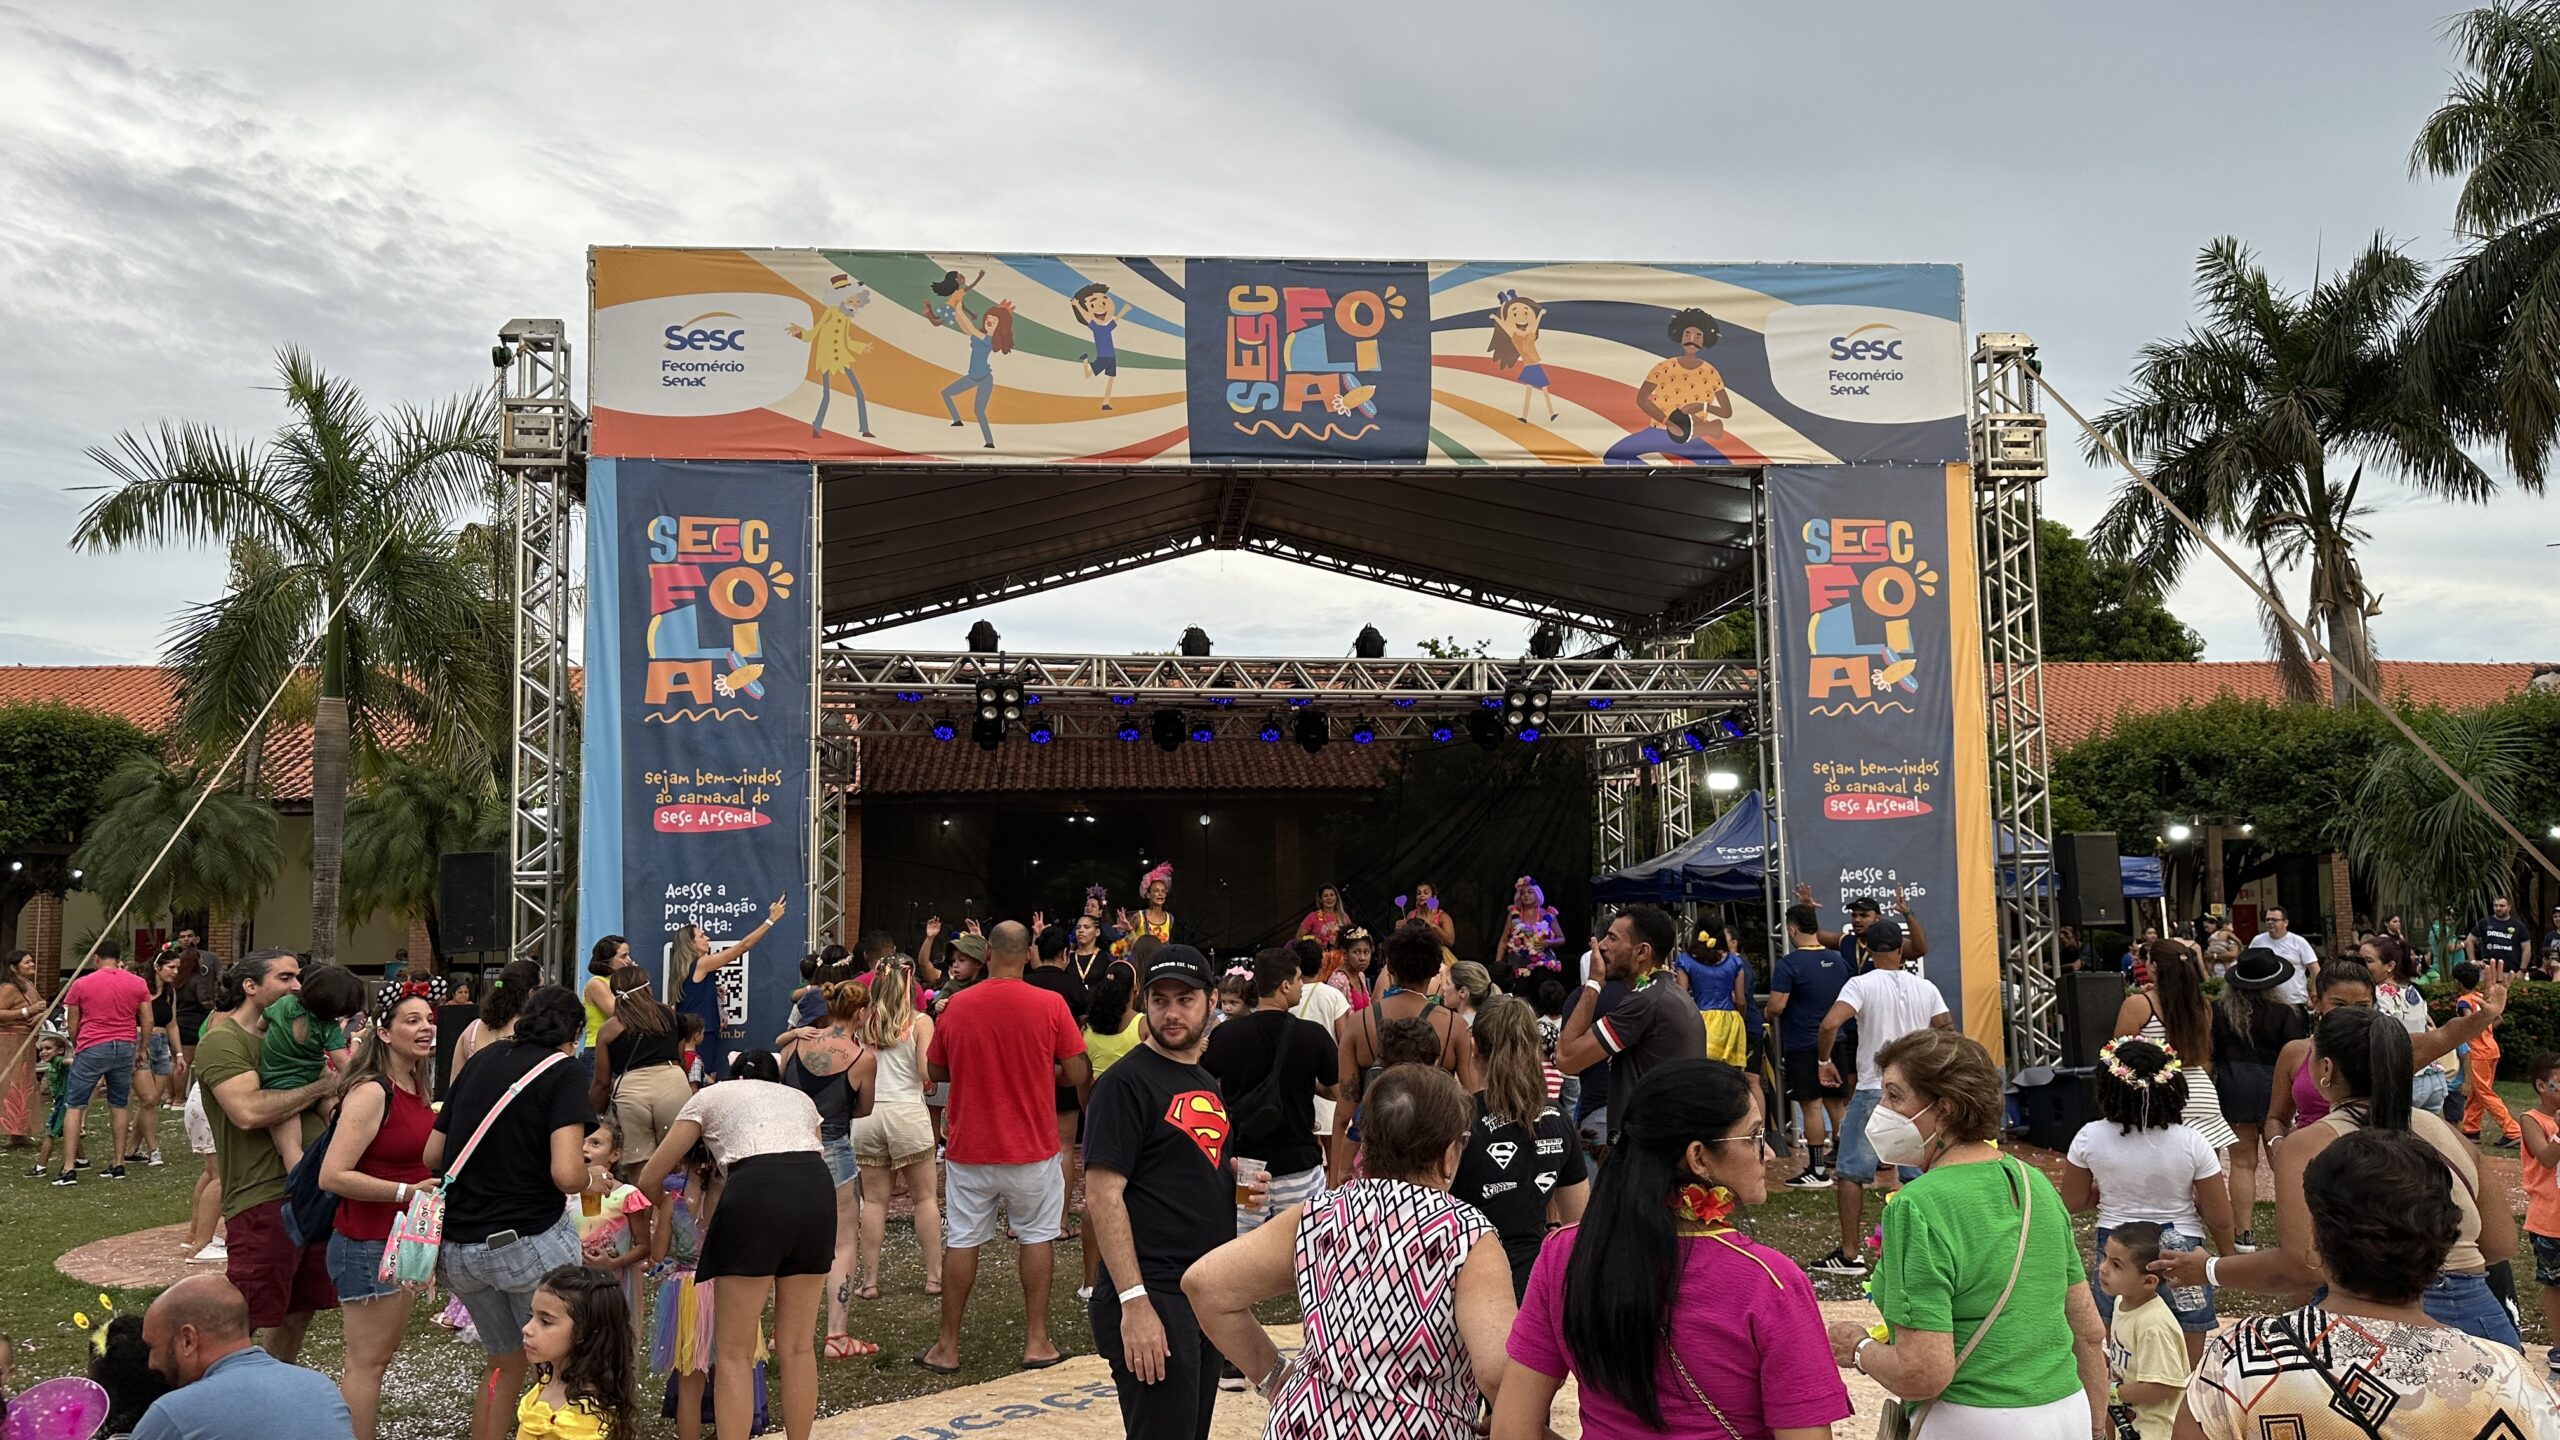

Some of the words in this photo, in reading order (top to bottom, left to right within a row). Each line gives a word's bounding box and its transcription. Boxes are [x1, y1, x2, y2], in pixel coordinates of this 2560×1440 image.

[664, 325, 744, 351] Sesc
[1830, 337, 1902, 361] Sesc
[662, 360, 744, 372] Fecomércio
[1829, 369, 1903, 380] Fecomércio
[662, 376, 706, 387] Senac
[1830, 385, 1870, 395] Senac
[648, 515, 769, 564] SESC
[1802, 518, 1914, 564] SESC
[1813, 760, 1855, 783] sejam
[644, 769, 689, 794] sejam
[1824, 783, 1840, 793] ao
[1846, 777, 1907, 794] carnaval
[1913, 777, 1930, 794] do
[655, 793, 672, 804] ao
[679, 787, 745, 804] carnaval
[752, 787, 770, 804] do
[1865, 795, 1920, 814] Arsenal
[698, 806, 757, 825] Arsenal
[1840, 868, 1883, 883] Acesse
[1888, 869, 1896, 880] a
[665, 882, 712, 899] Acesse
[718, 884, 726, 896] a
[665, 897, 757, 922] programação
[720, 1029, 747, 1039] m.br
